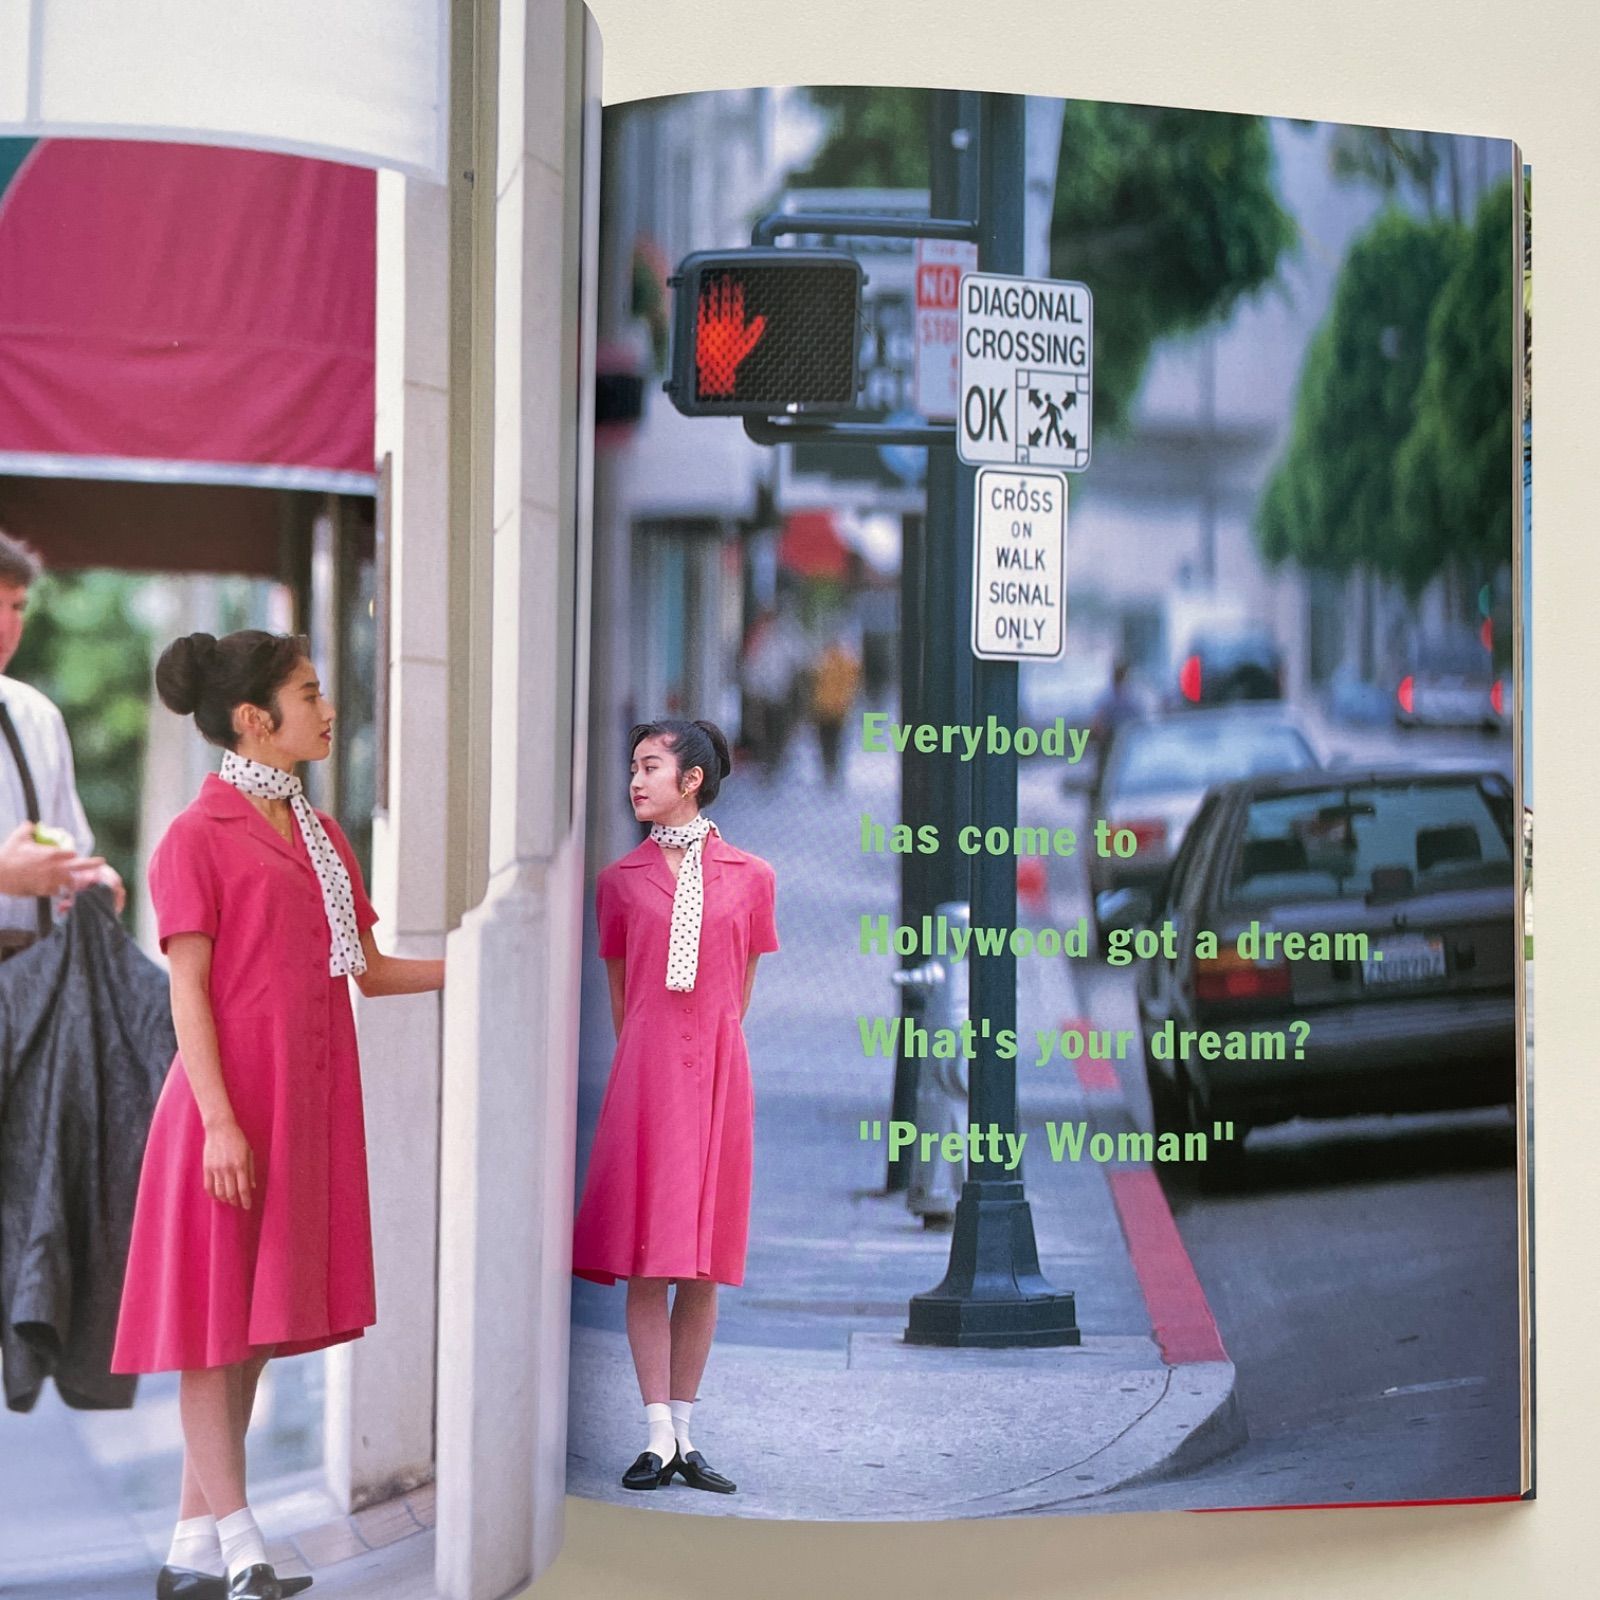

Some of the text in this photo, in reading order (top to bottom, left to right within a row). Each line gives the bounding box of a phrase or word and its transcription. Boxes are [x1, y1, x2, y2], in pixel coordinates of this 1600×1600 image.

[921, 268, 956, 306] NO
[967, 284, 1083, 324] DIAGONAL
[966, 326, 1086, 367] CROSSING
[964, 384, 1009, 443] OK
[991, 488, 1053, 513] CROSS
[1011, 520, 1032, 539] ON
[996, 546, 1046, 571] WALK
[989, 581, 1055, 607] SIGNAL
[995, 616, 1046, 642] ONLY
[861, 712, 1091, 764] Everybody
[860, 814, 1138, 859] has come to
[859, 914, 1384, 967] Hollywood got a dream.
[857, 1017, 1311, 1067] What's your dream?
[858, 1120, 1235, 1171] "Pretty Woman"
